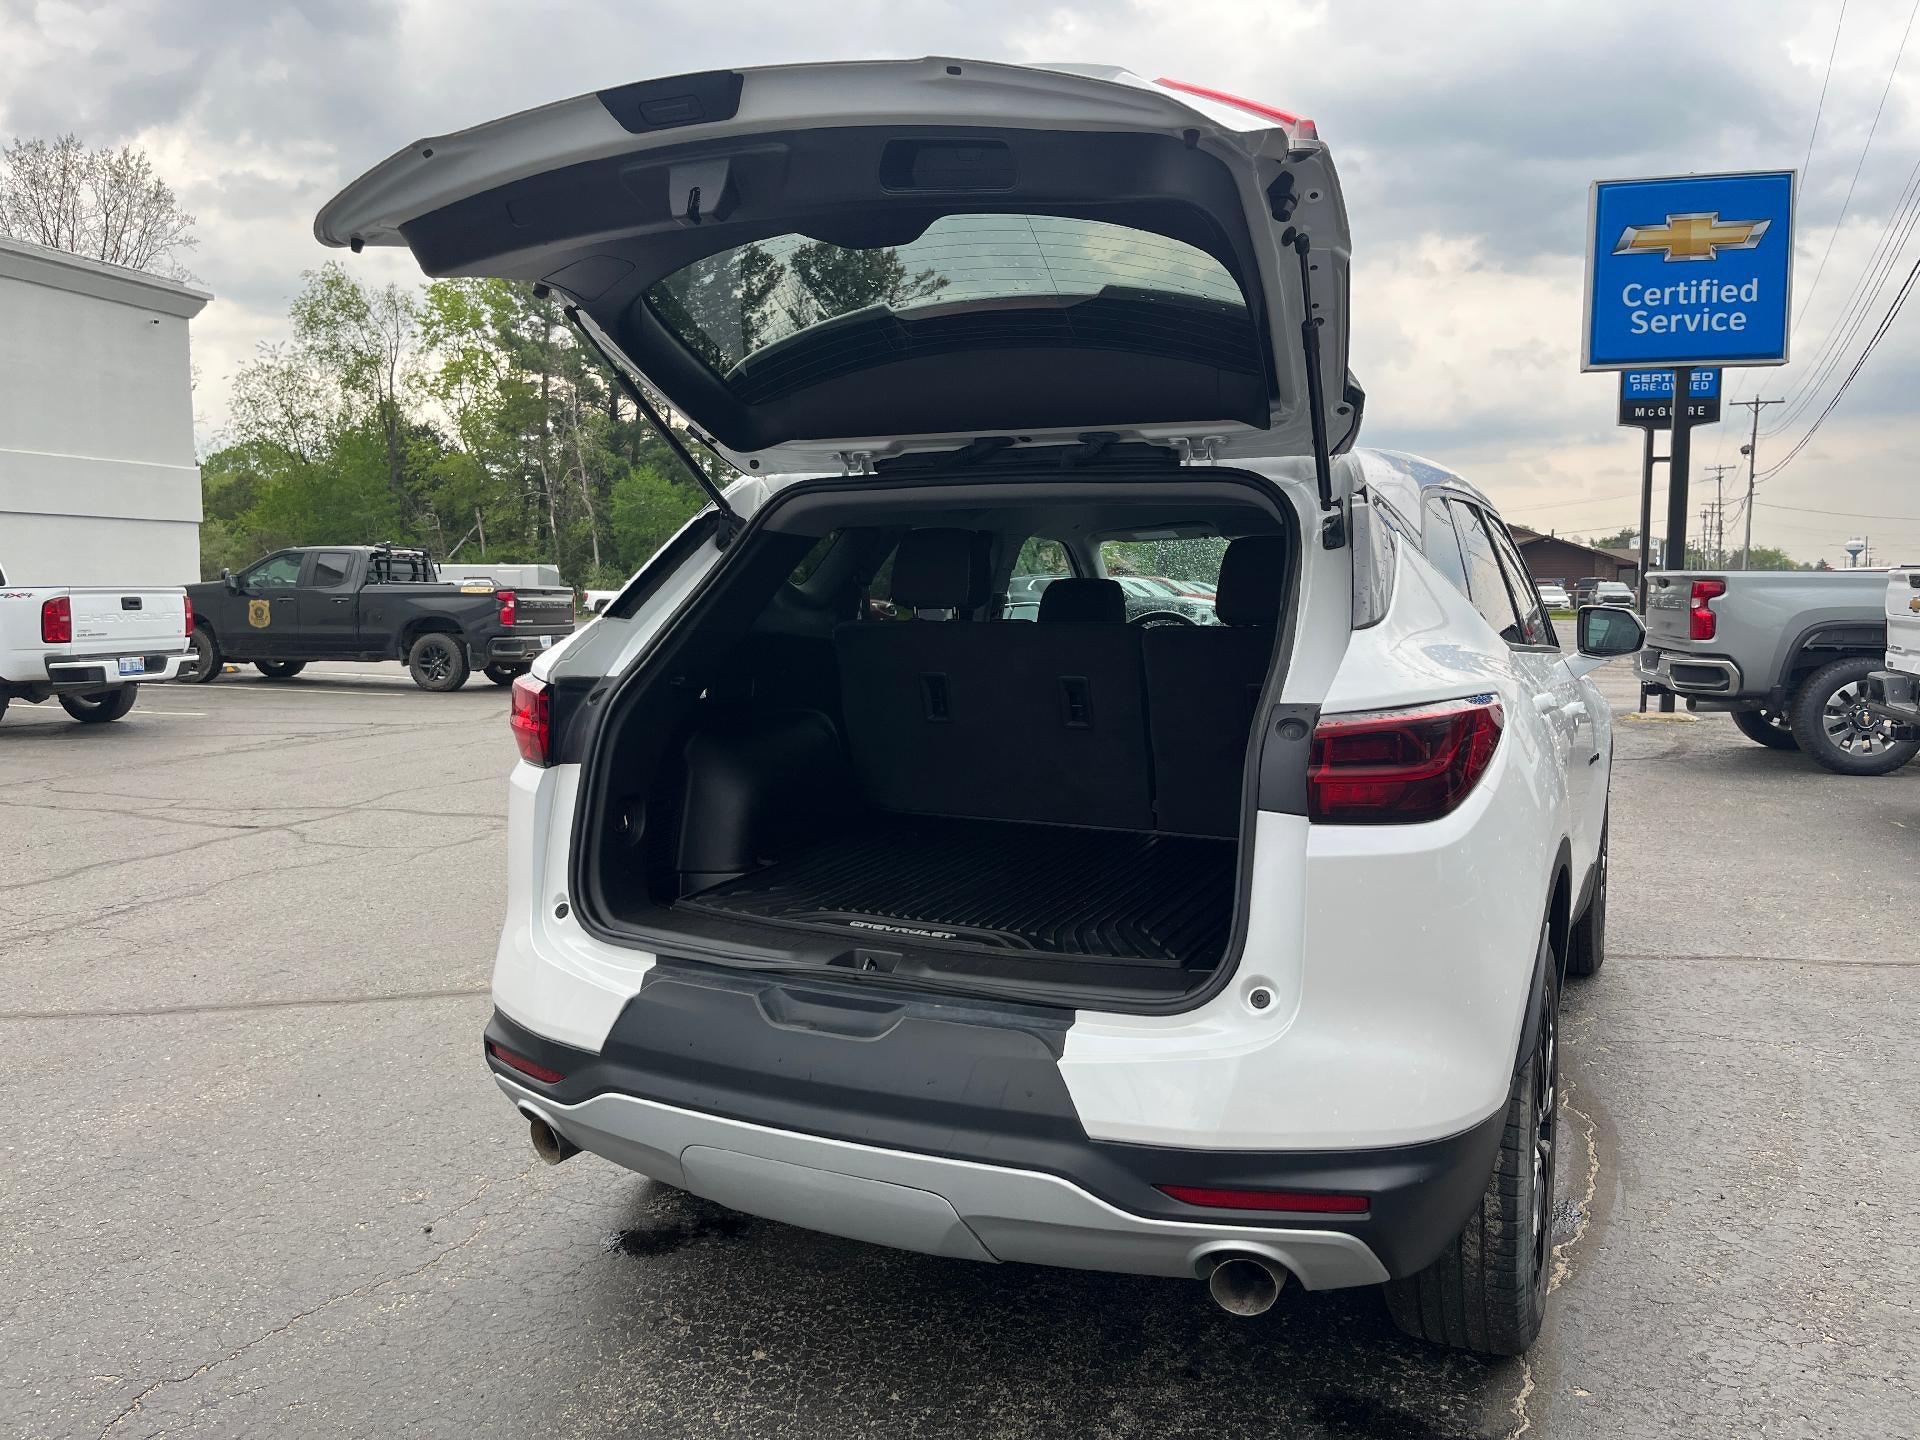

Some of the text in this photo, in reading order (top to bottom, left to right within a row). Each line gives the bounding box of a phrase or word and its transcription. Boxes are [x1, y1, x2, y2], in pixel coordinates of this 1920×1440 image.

[1622, 278, 1758, 307] Certified
[1631, 308, 1747, 334] Service
[1629, 372, 1714, 383] CERTIED
[1632, 381, 1710, 391] PRE-OED
[1635, 406, 1705, 417] McGRE
[850, 921, 957, 939] CHEVROLET
